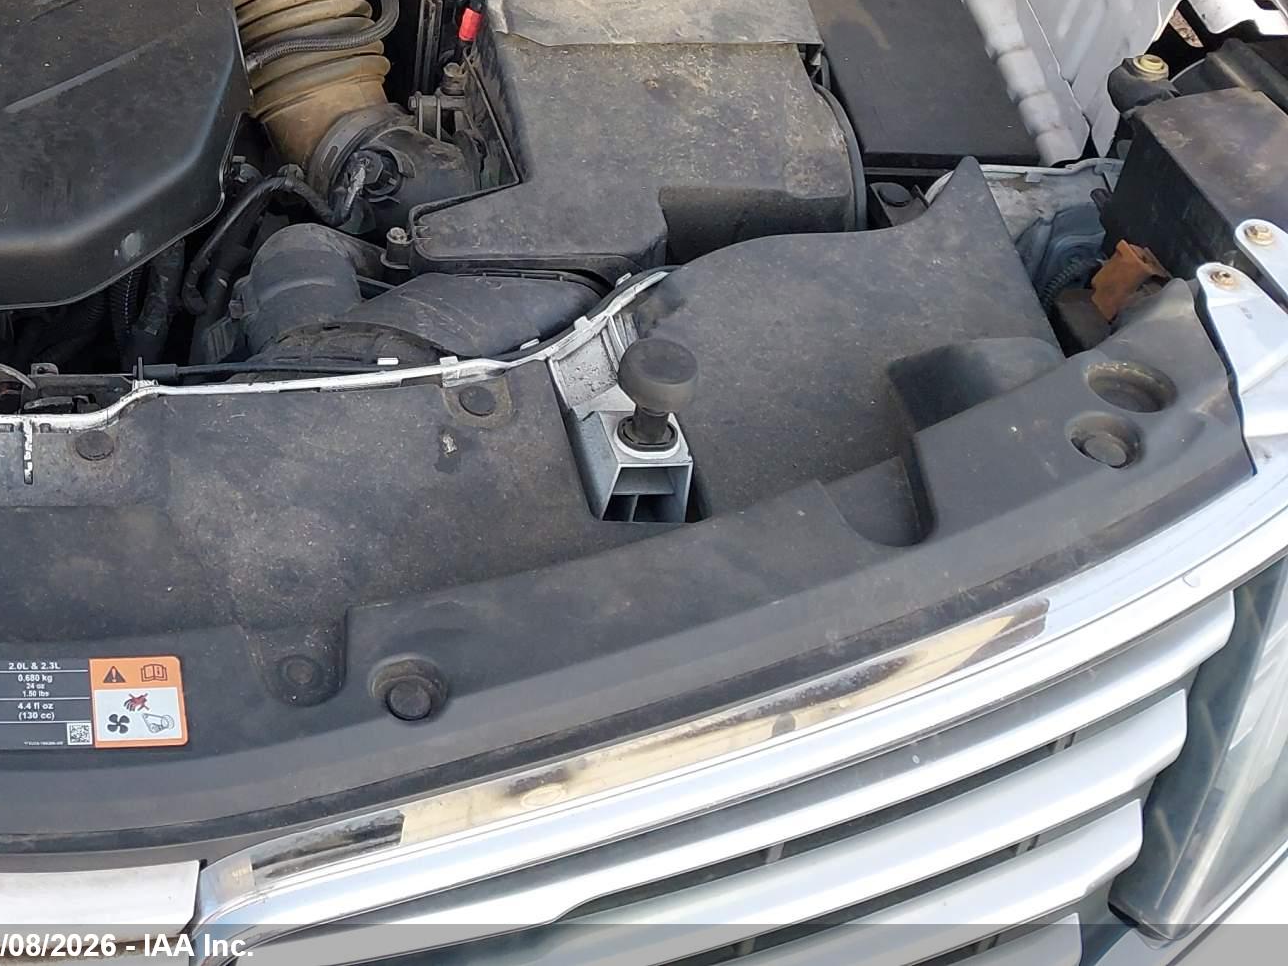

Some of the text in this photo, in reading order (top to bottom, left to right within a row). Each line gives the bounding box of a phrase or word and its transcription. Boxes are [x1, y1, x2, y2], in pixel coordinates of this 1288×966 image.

[8, 661, 61, 670] 2.0L & 2.3L
[17, 673, 53, 683] 0.680 kg
[17, 702, 32, 710] 4.4
[33, 702, 40, 710] fl
[18, 711, 55, 721] (130 cc)
